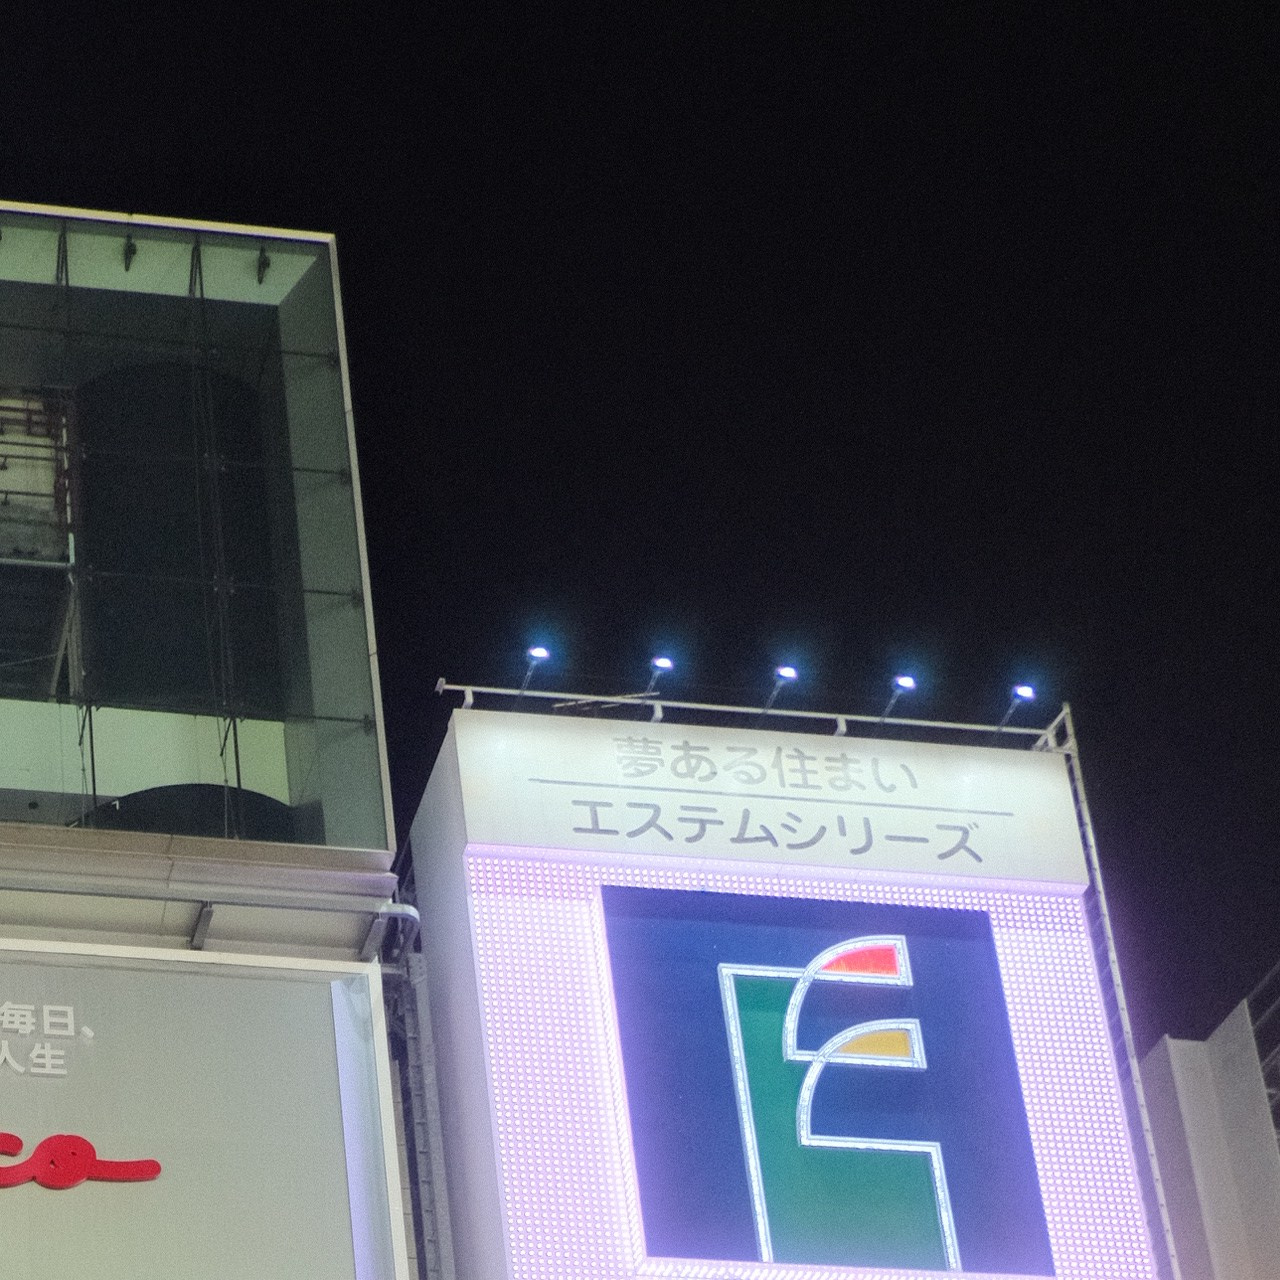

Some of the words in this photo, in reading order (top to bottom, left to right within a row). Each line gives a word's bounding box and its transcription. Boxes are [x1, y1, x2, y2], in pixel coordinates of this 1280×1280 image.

[615, 736, 919, 793] 夢ある住まい
[572, 799, 983, 864] エステムシリーズ
